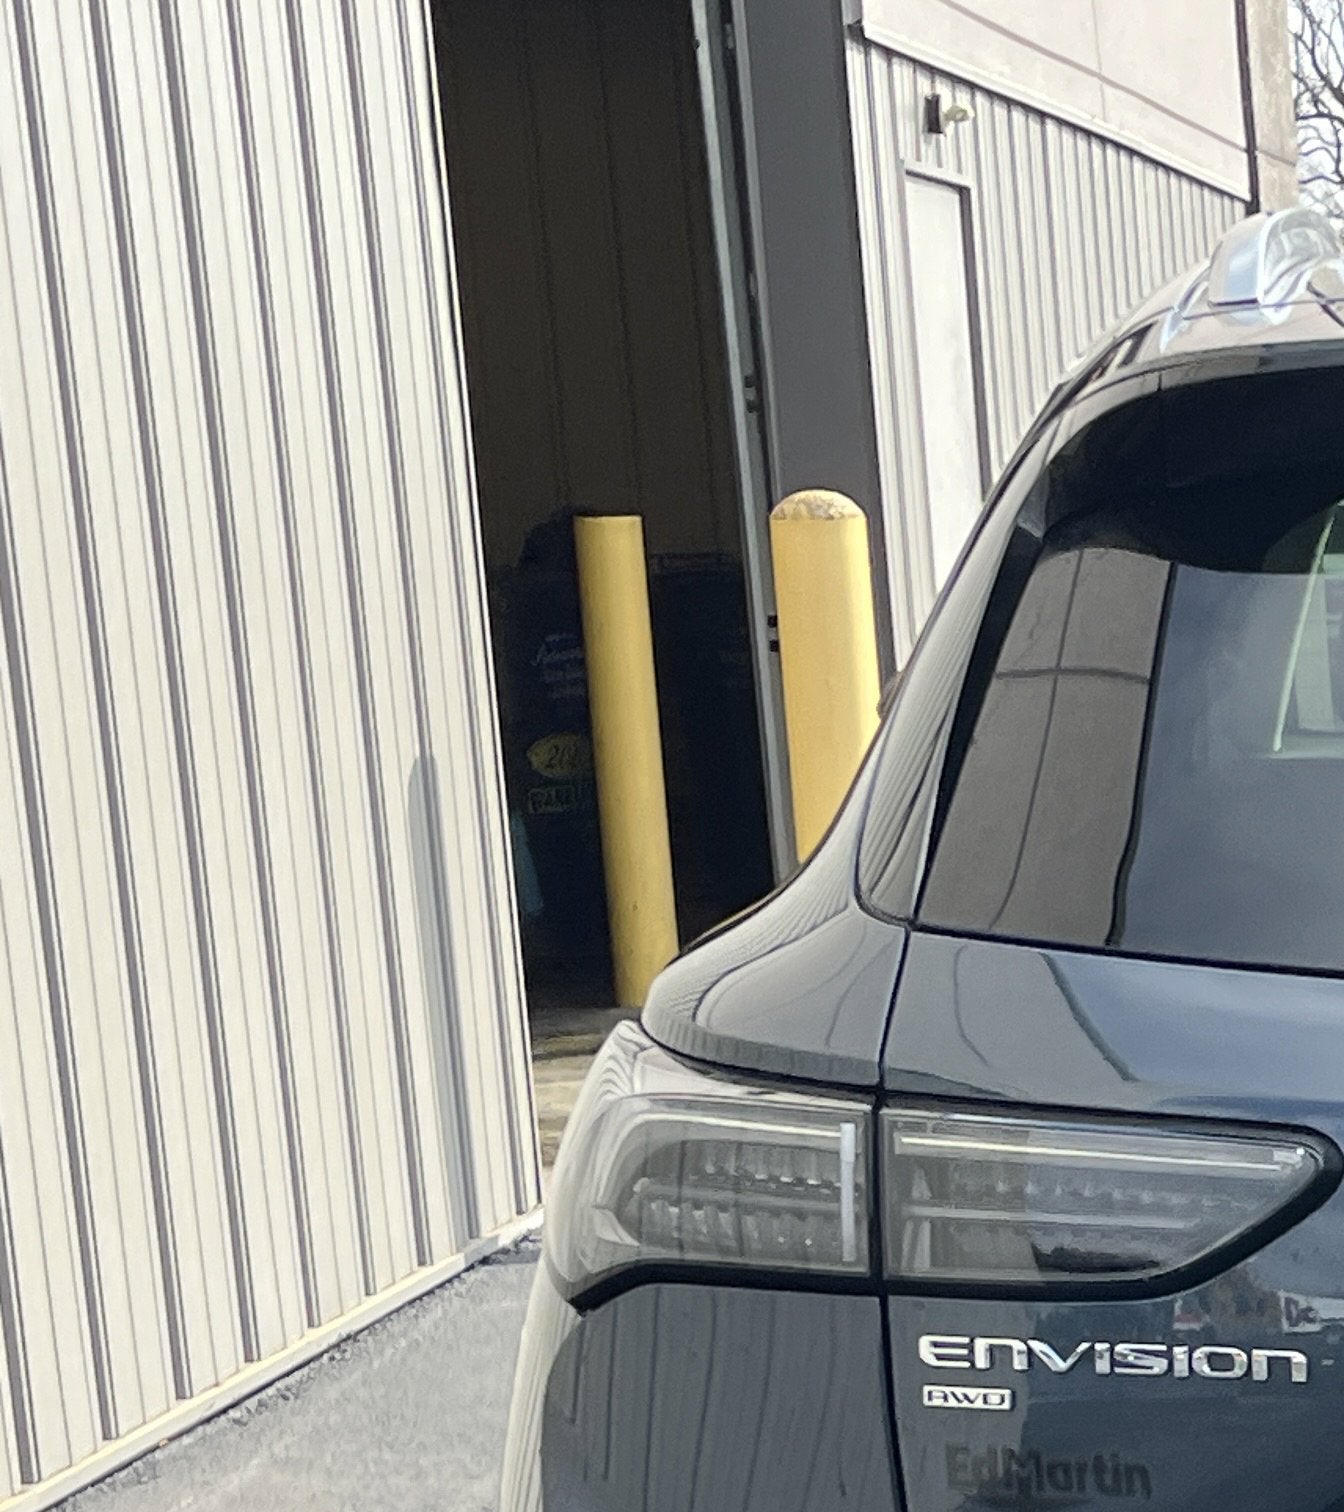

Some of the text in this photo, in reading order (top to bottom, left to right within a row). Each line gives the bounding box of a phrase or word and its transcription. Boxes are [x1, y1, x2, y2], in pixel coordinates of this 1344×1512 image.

[917, 1335, 1309, 1383] ENVISION
[925, 1388, 1009, 1408] AWD
[944, 1442, 1152, 1502] EdMartin
